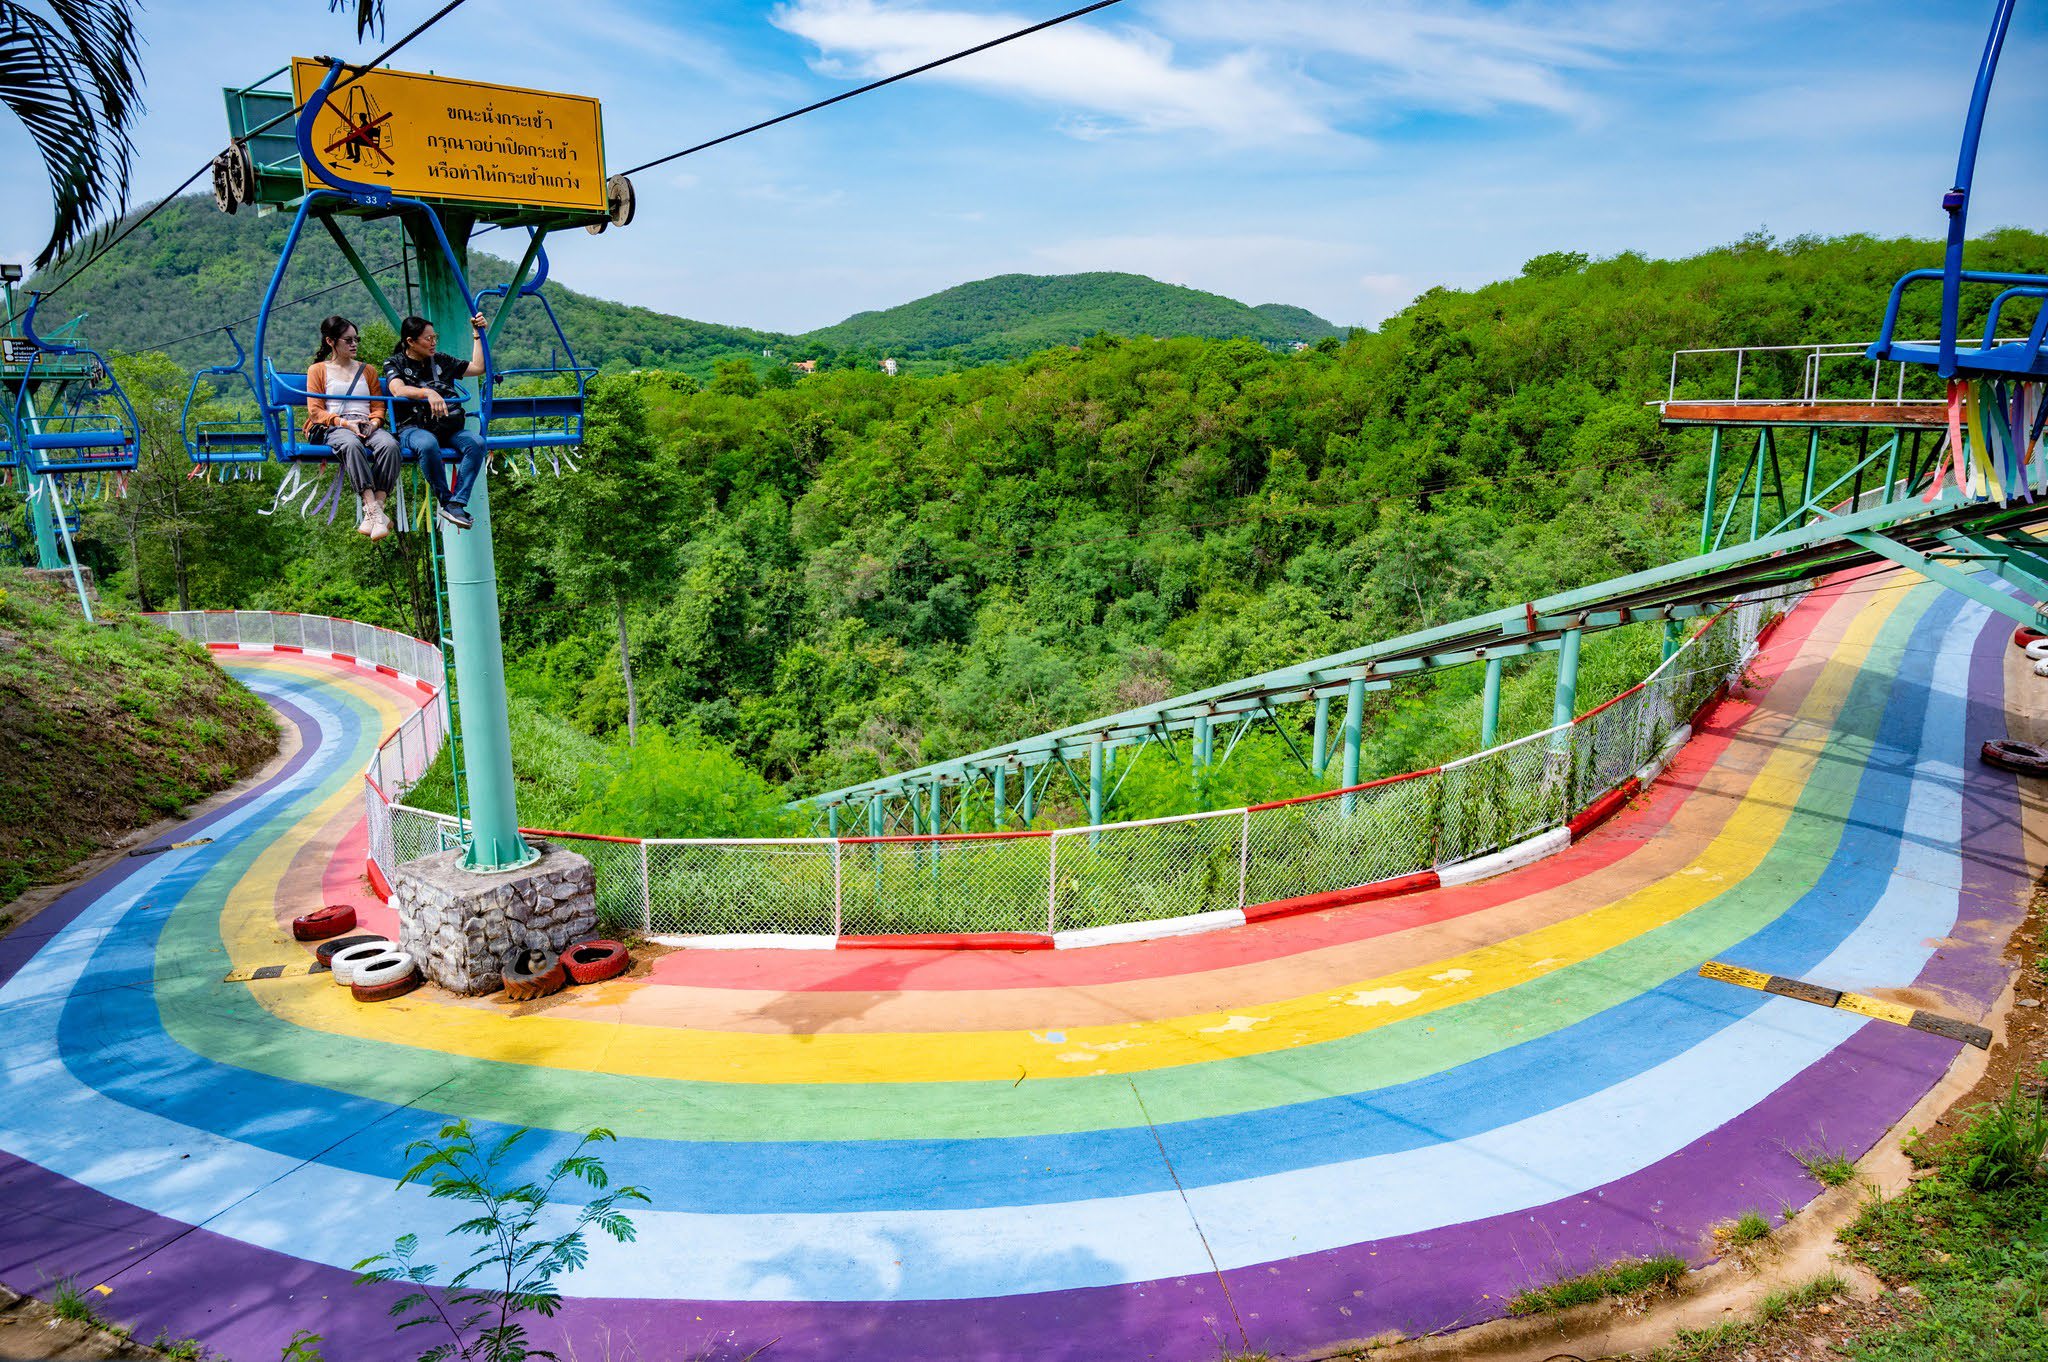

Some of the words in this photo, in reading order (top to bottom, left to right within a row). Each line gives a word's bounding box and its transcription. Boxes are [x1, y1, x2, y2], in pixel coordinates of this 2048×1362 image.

[447, 102, 553, 129] ขณะนั่งกระเช้า
[427, 134, 577, 161] กรุณาอย่าเปิดกระเช้า
[428, 161, 580, 189] หรือทำให้กระเช้าแกว่ง
[365, 195, 378, 205] 33
